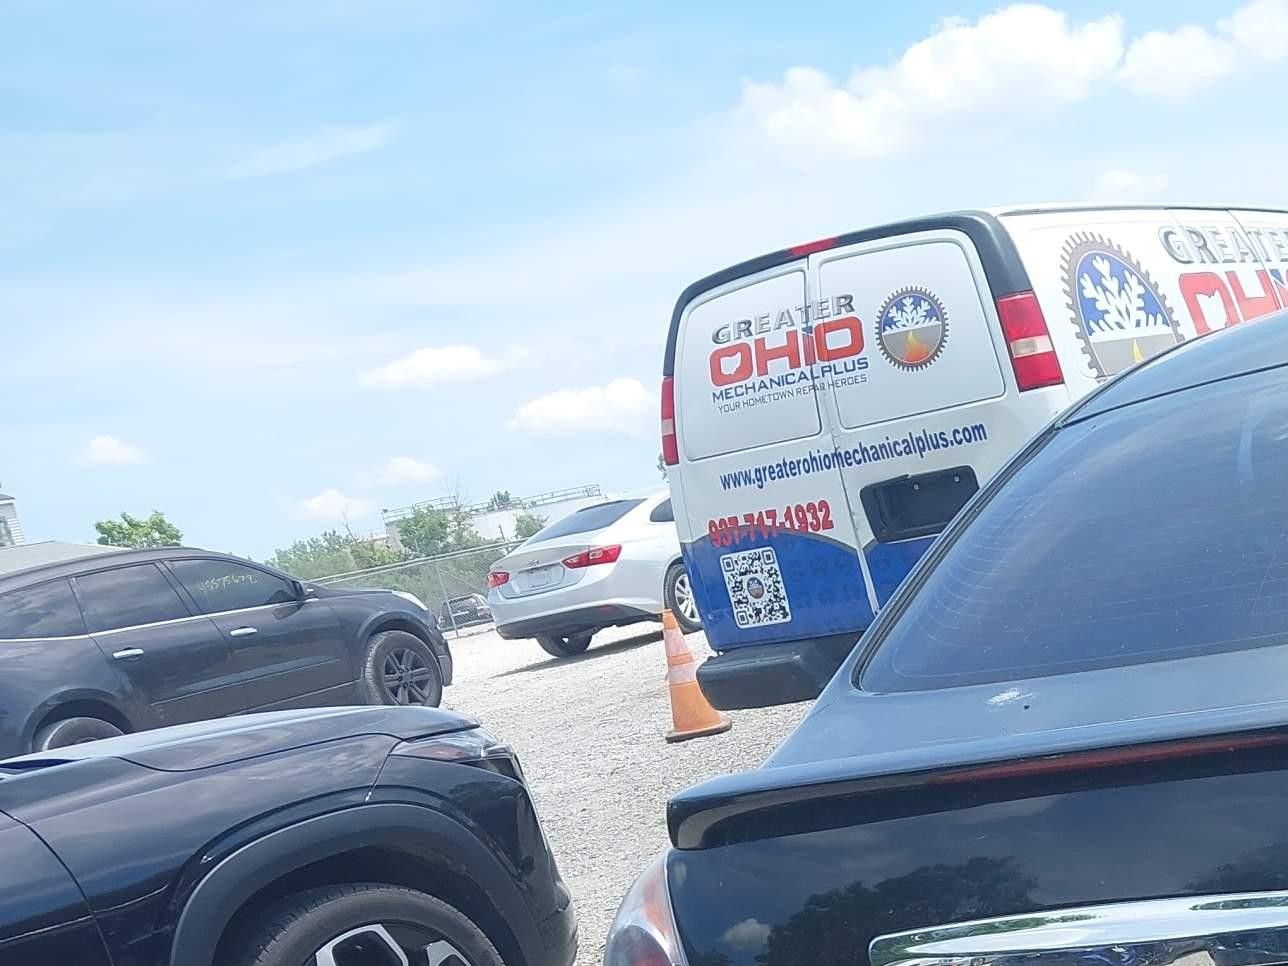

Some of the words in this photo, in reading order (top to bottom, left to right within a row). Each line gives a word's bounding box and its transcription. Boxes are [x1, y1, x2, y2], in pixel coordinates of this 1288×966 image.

[711, 293, 855, 345] GREATER
[718, 400, 741, 415] YOUR
[742, 389, 795, 408] HOMETOWN
[796, 381, 826, 397] REPAIR
[827, 373, 867, 390] HEROES
[720, 423, 988, 491] www.greaterohiomechanicalplus.com
[708, 500, 835, 548] 937-717-1932
